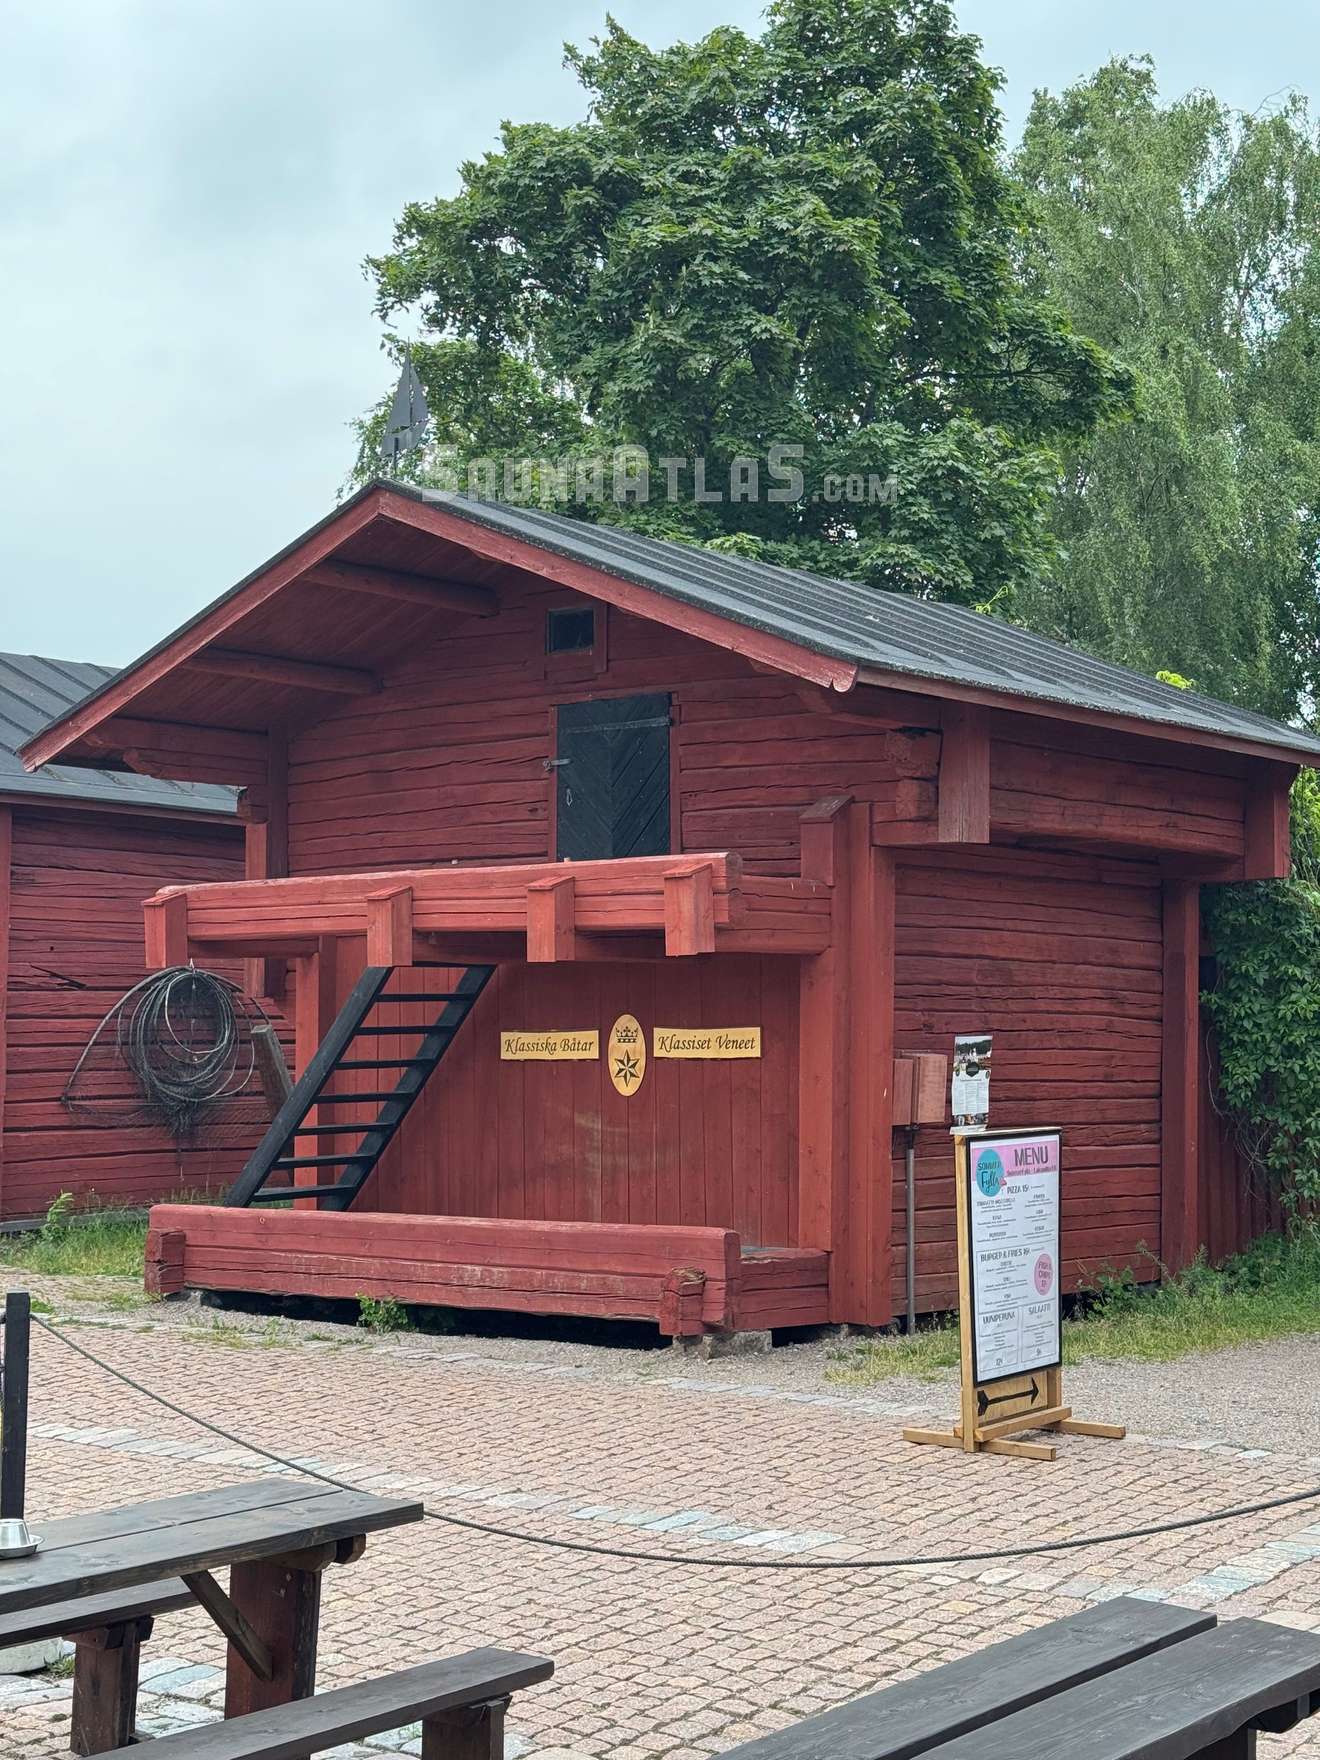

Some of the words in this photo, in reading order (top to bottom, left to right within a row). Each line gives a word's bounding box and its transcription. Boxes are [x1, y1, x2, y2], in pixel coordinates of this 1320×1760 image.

[504, 1037, 557, 1055] Klassiska
[560, 1037, 594, 1052] Båtar
[657, 1035, 711, 1053] Klassiset
[715, 1035, 756, 1050] Veneet
[1014, 1145, 1049, 1166] MENU
[1007, 1185, 1022, 1194] PIZZA
[980, 1251, 1003, 1262] BURGER
[1007, 1248, 1023, 1258] FRIES
